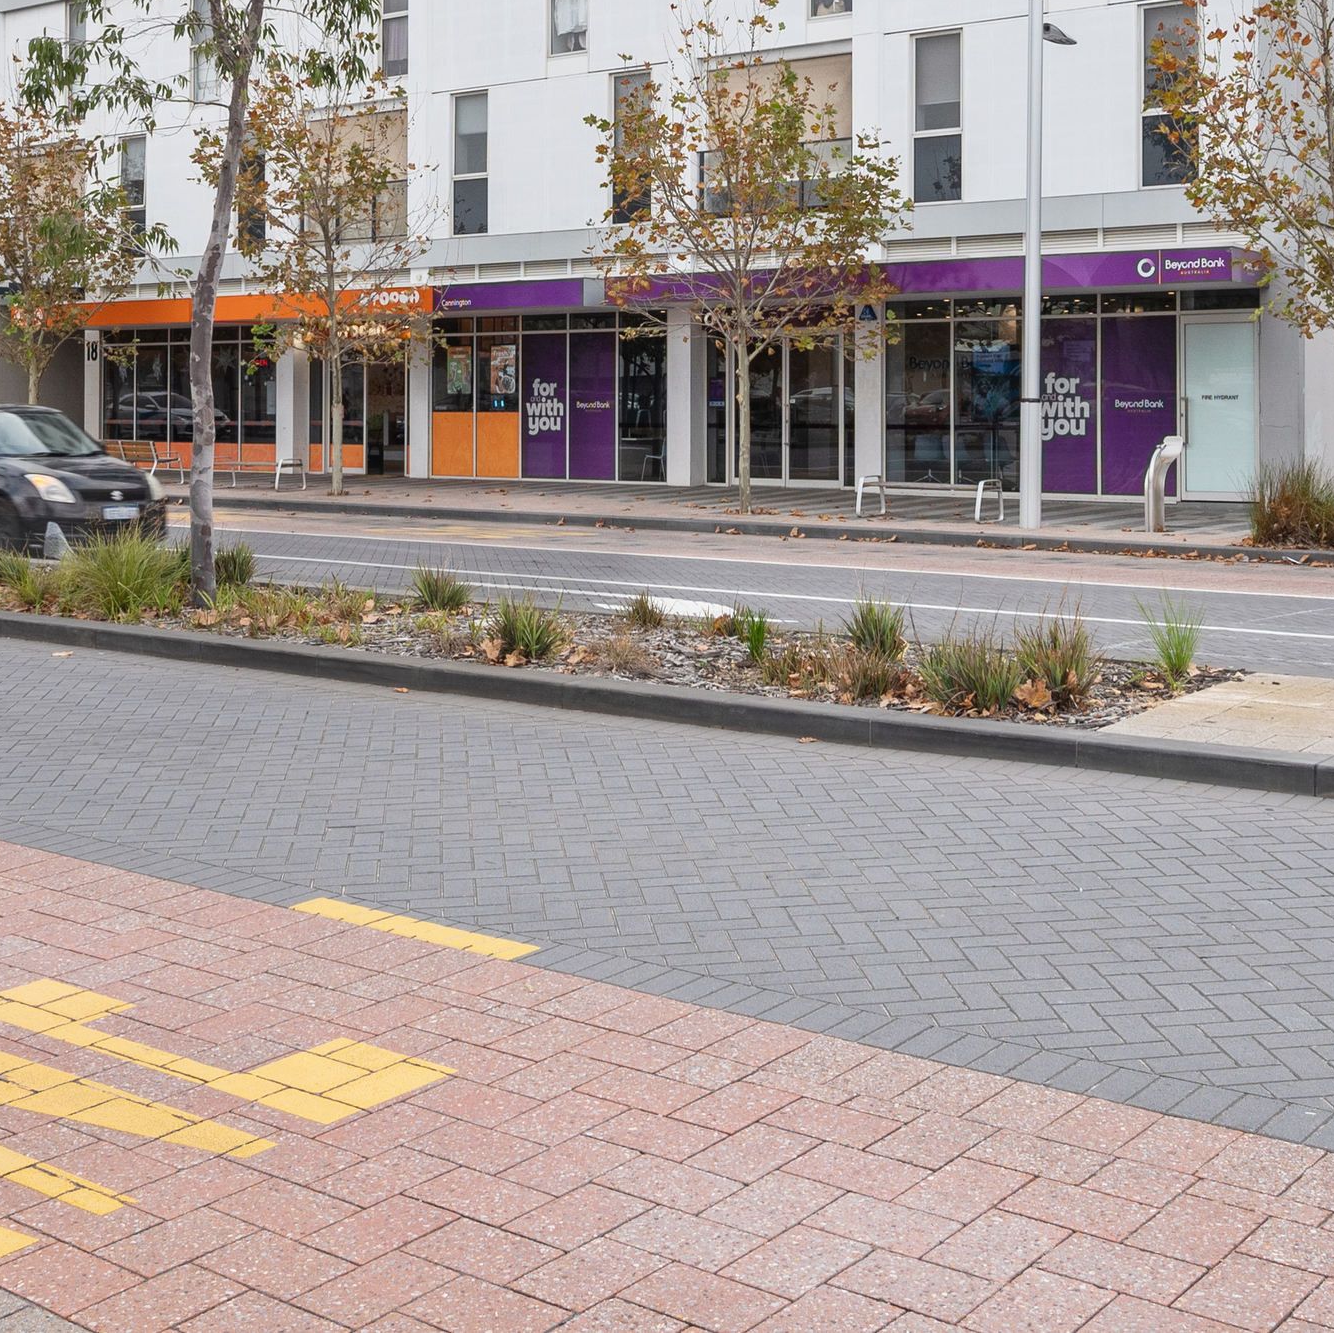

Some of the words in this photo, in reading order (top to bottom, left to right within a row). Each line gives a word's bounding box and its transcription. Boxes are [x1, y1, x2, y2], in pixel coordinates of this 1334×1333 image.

[1165, 258, 1200, 270] Beyond
[1201, 257, 1225, 268] Bank
[441, 299, 472, 308] Cannington
[86, 341, 98, 361] 18
[532, 378, 557, 397] for
[1045, 372, 1080, 395] for
[526, 397, 564, 417] with
[576, 401, 597, 409] Beyond
[1040, 394, 1090, 418] with
[1115, 399, 1144, 409] Beyond
[1144, 399, 1164, 408] Bank
[528, 416, 561, 435] you
[1041, 418, 1086, 441] you
